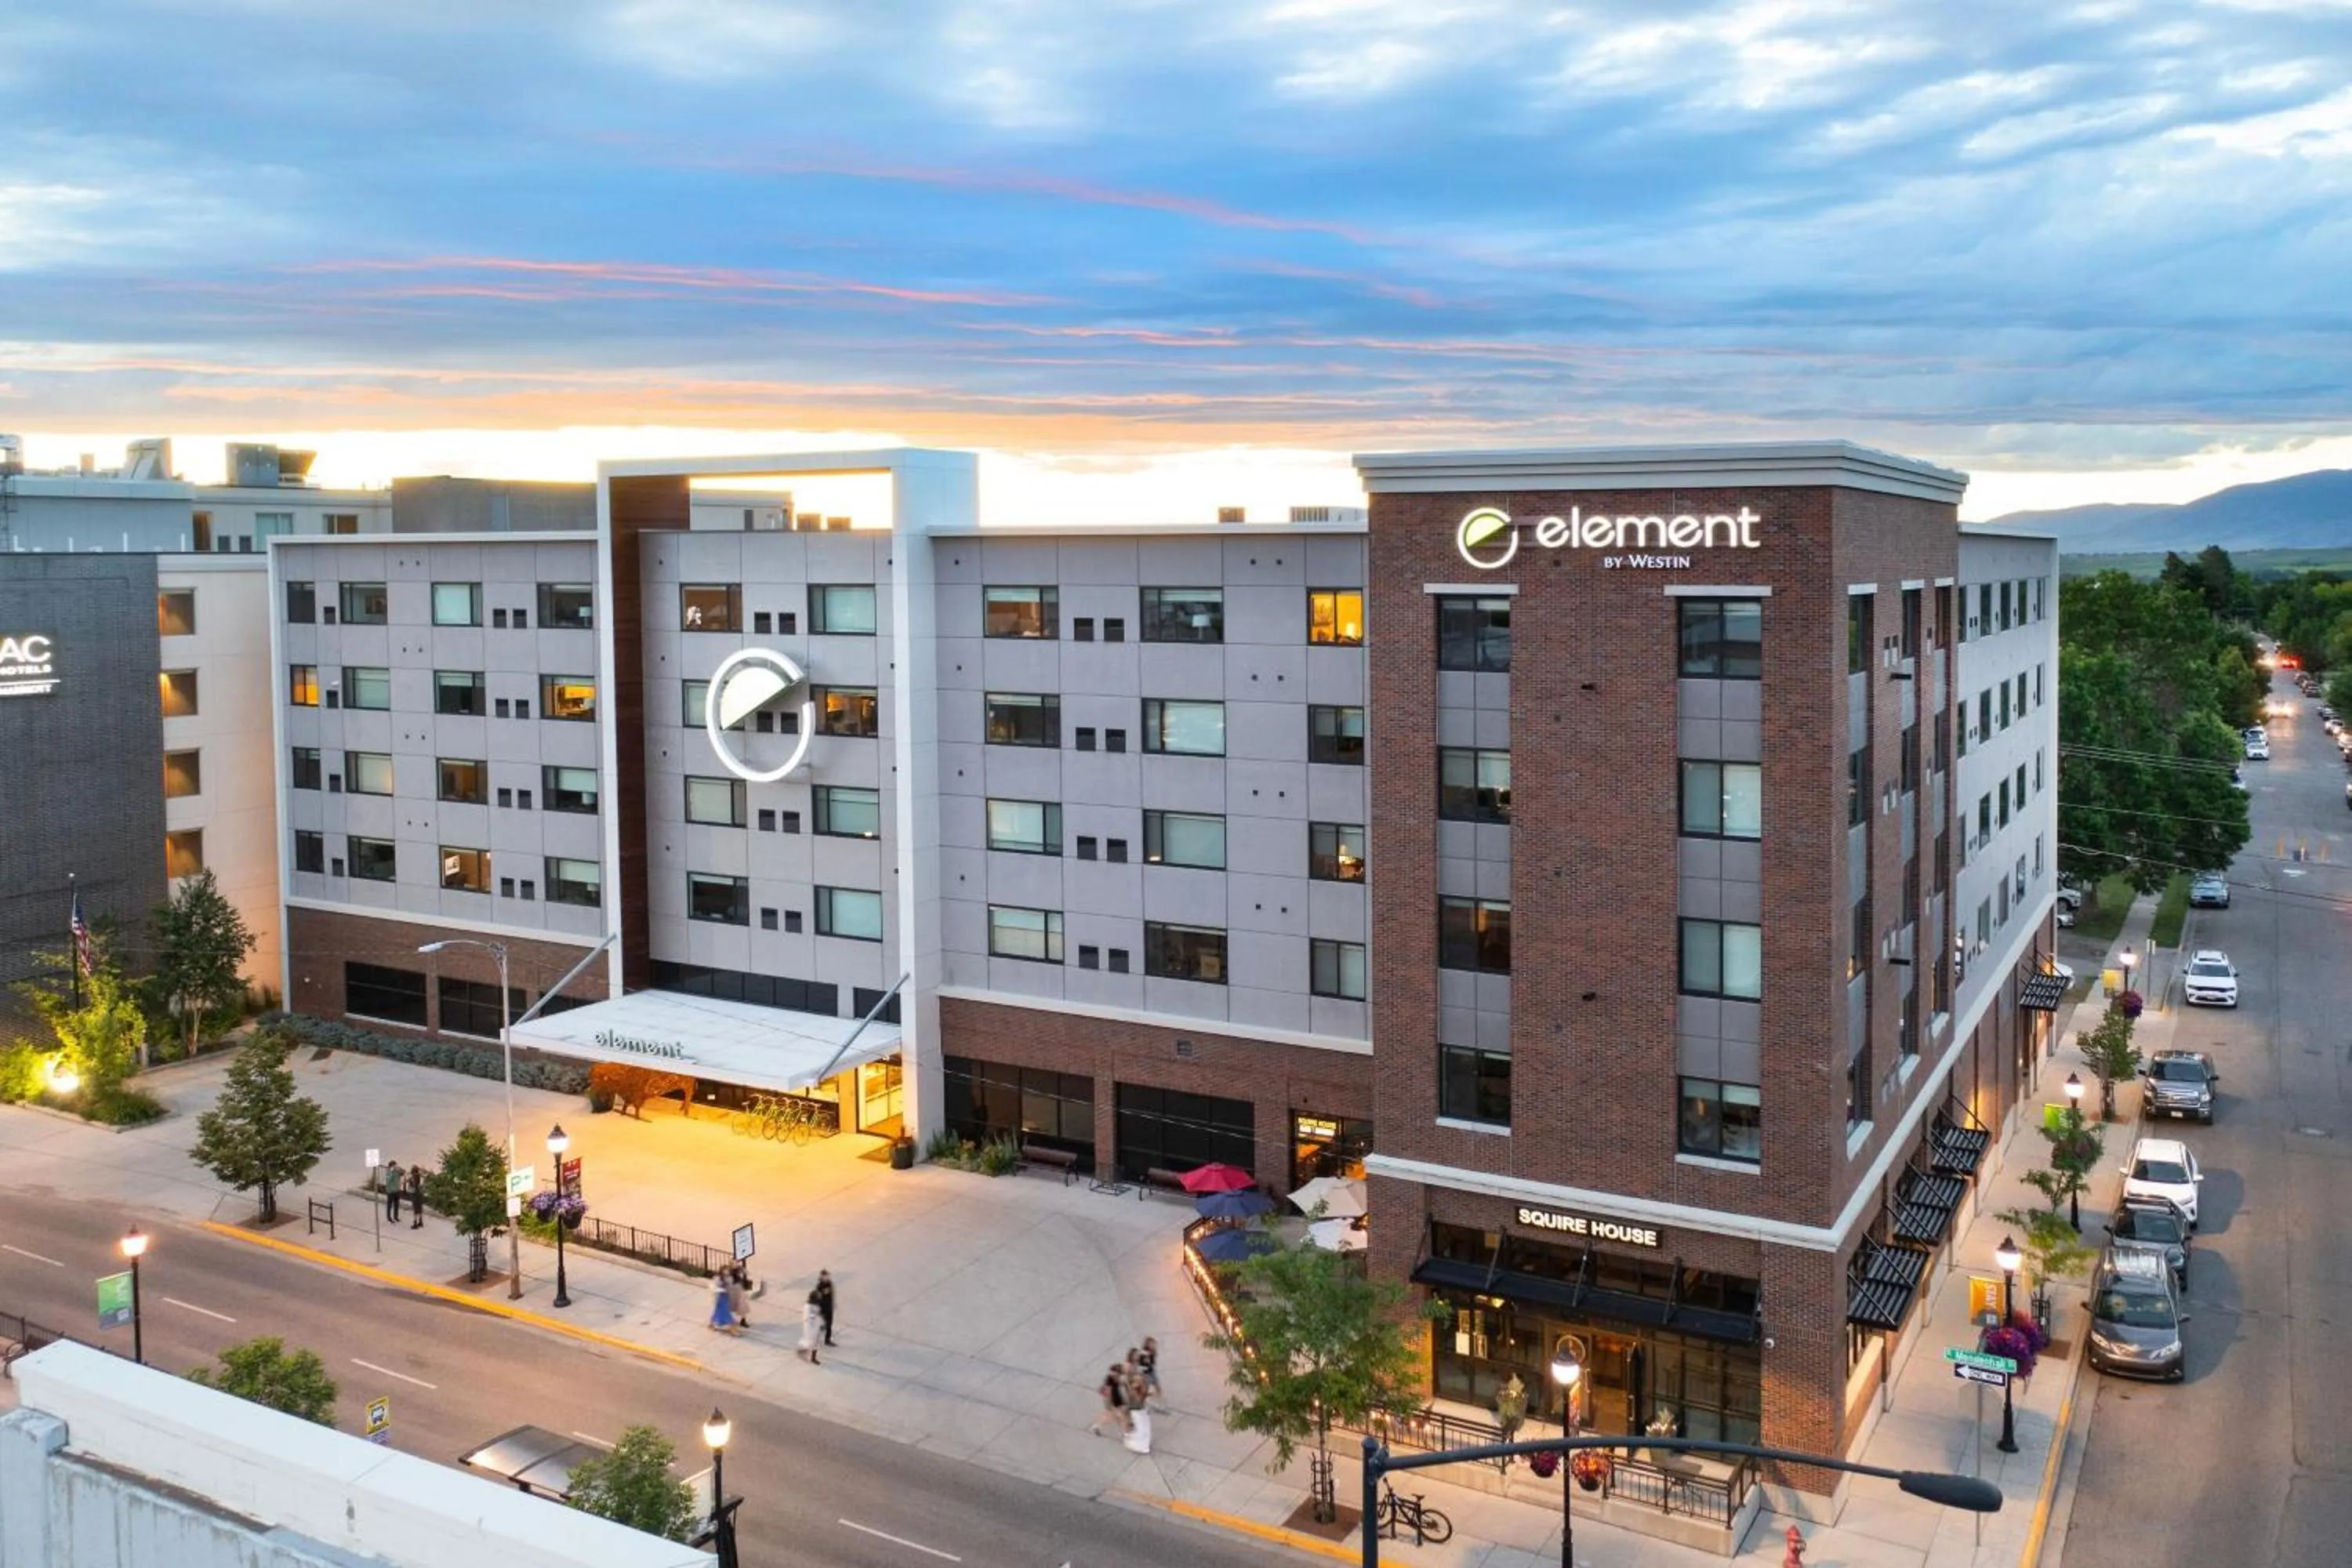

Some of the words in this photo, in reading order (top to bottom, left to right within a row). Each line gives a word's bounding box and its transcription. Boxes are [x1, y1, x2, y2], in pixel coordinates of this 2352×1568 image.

[1536, 506, 1761, 548] element
[1604, 557, 1623, 568] BY
[0, 636, 51, 664] AC
[594, 1028, 684, 1058] element
[1518, 1208, 1588, 1234] SQUIRE
[1591, 1221, 1657, 1247] HOUSE
